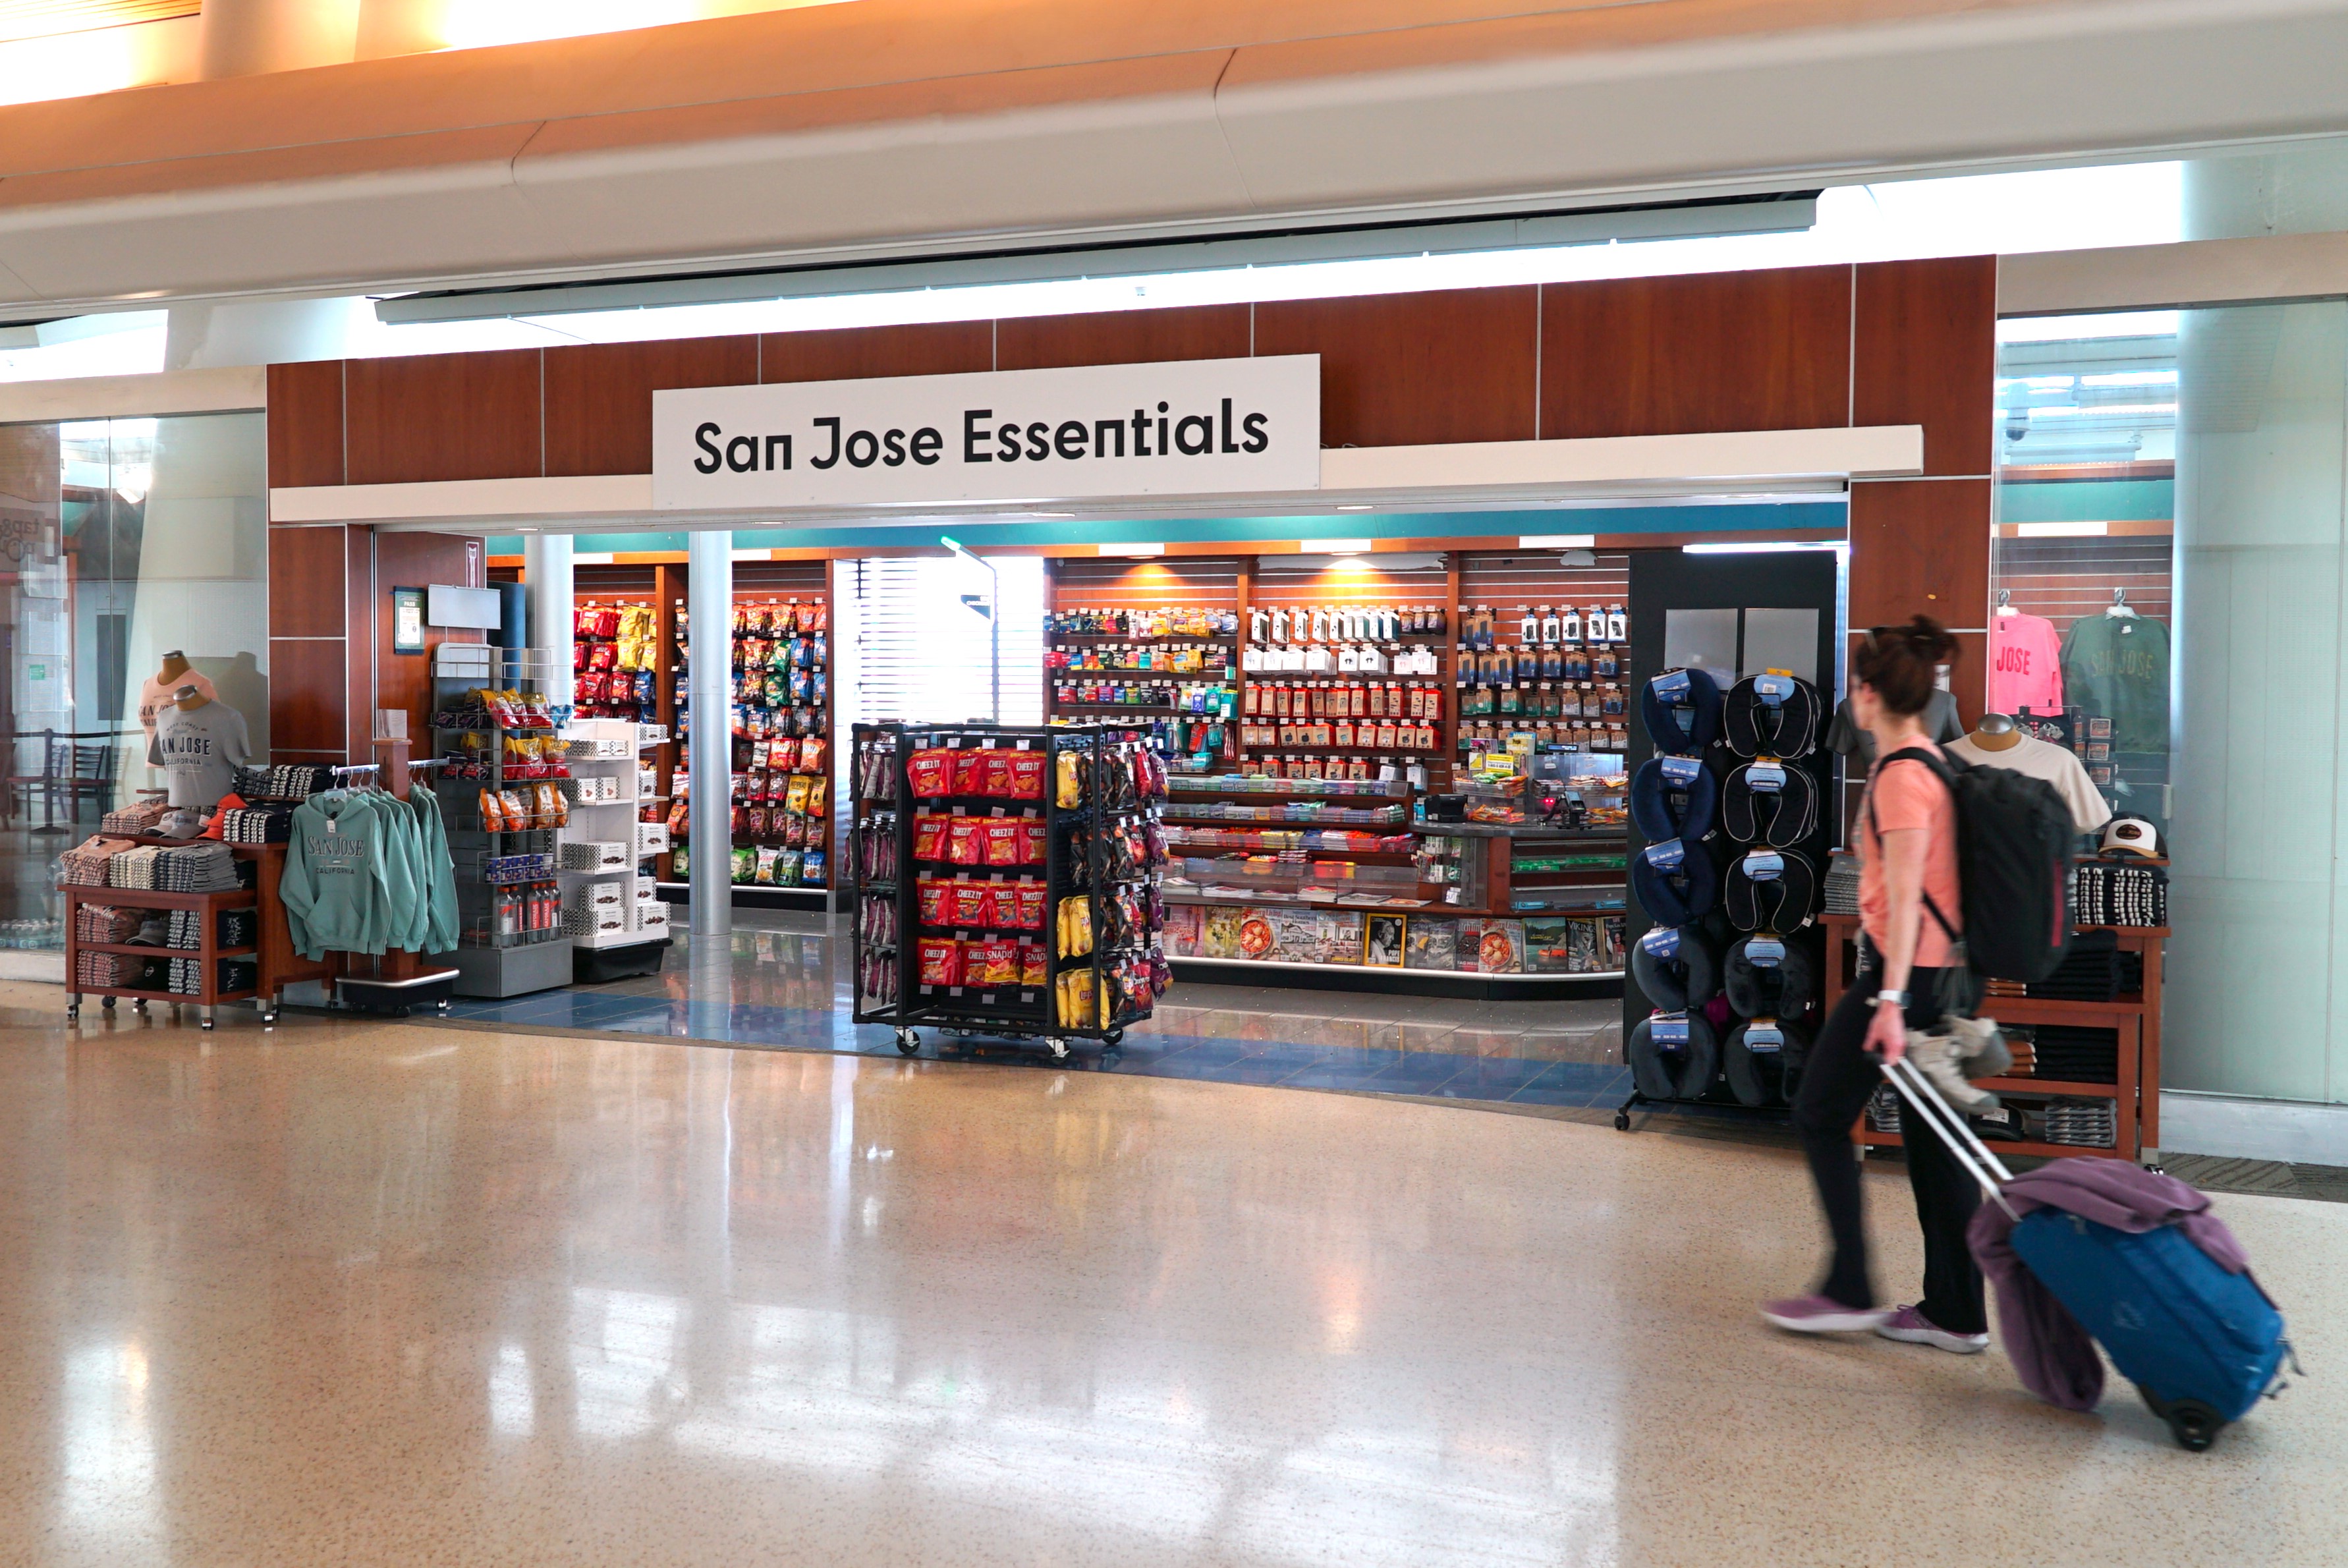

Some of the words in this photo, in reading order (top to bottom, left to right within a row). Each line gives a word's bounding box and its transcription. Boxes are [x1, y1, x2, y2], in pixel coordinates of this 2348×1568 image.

[694, 422, 791, 474] San
[810, 416, 943, 470] Jose
[964, 397, 1269, 463] Essentials
[1997, 646, 2030, 675] JOSE
[2092, 650, 2114, 678] SAN
[2119, 650, 2153, 679] JOSE
[162, 737, 175, 754] AN
[180, 737, 211, 755] JOSE
[308, 836, 333, 856] SAN
[335, 837, 365, 857] JOSE
[957, 889, 975, 899] CHEEZ
[1457, 920, 1480, 932] atchTim
[1569, 922, 1596, 933] VIKINGS
[924, 949, 940, 958] CHEEZ
[968, 951, 985, 959] CHEEZ
